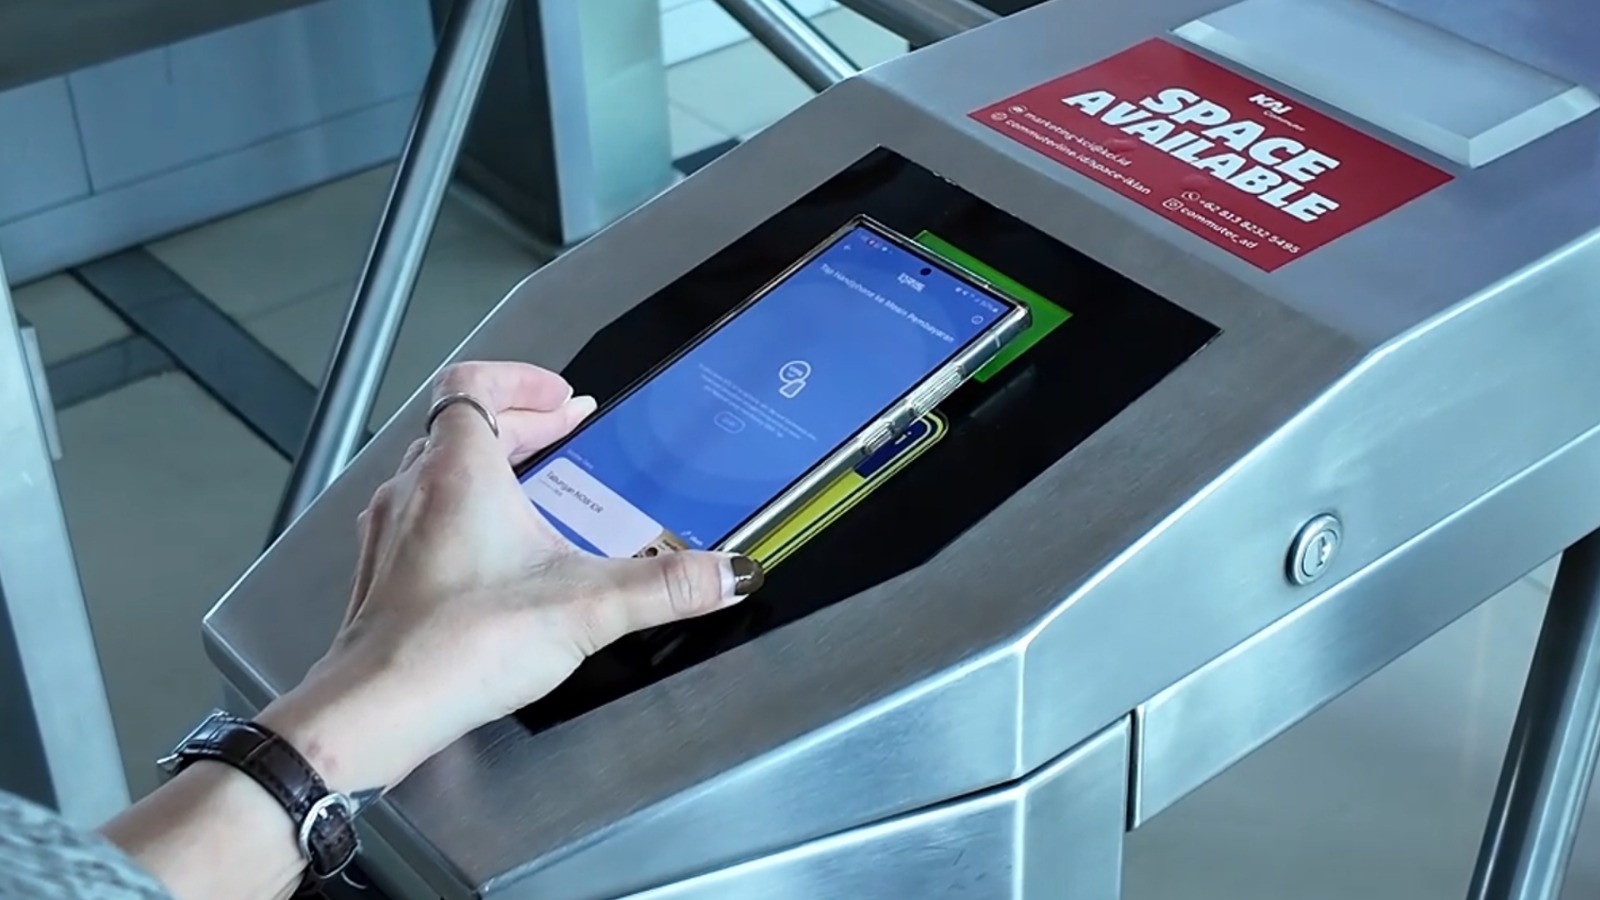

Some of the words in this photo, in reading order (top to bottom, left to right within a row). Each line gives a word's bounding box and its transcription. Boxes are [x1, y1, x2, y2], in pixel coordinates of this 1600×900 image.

[1023, 111, 1132, 167] marketing-kci@kci.id
[1139, 87, 1340, 182] SPACE
[1248, 93, 1293, 114] KAI
[1004, 118, 1152, 195] commuterline.id/space-iklan
[1060, 90, 1340, 222] AVAILABLE
[1199, 199, 1220, 213] +62
[1218, 209, 1242, 224] 813
[1239, 221, 1271, 239] 8232
[1268, 235, 1301, 254] 5495
[833, 269, 876, 298] Handphone
[906, 312, 955, 343] Pembayaran
